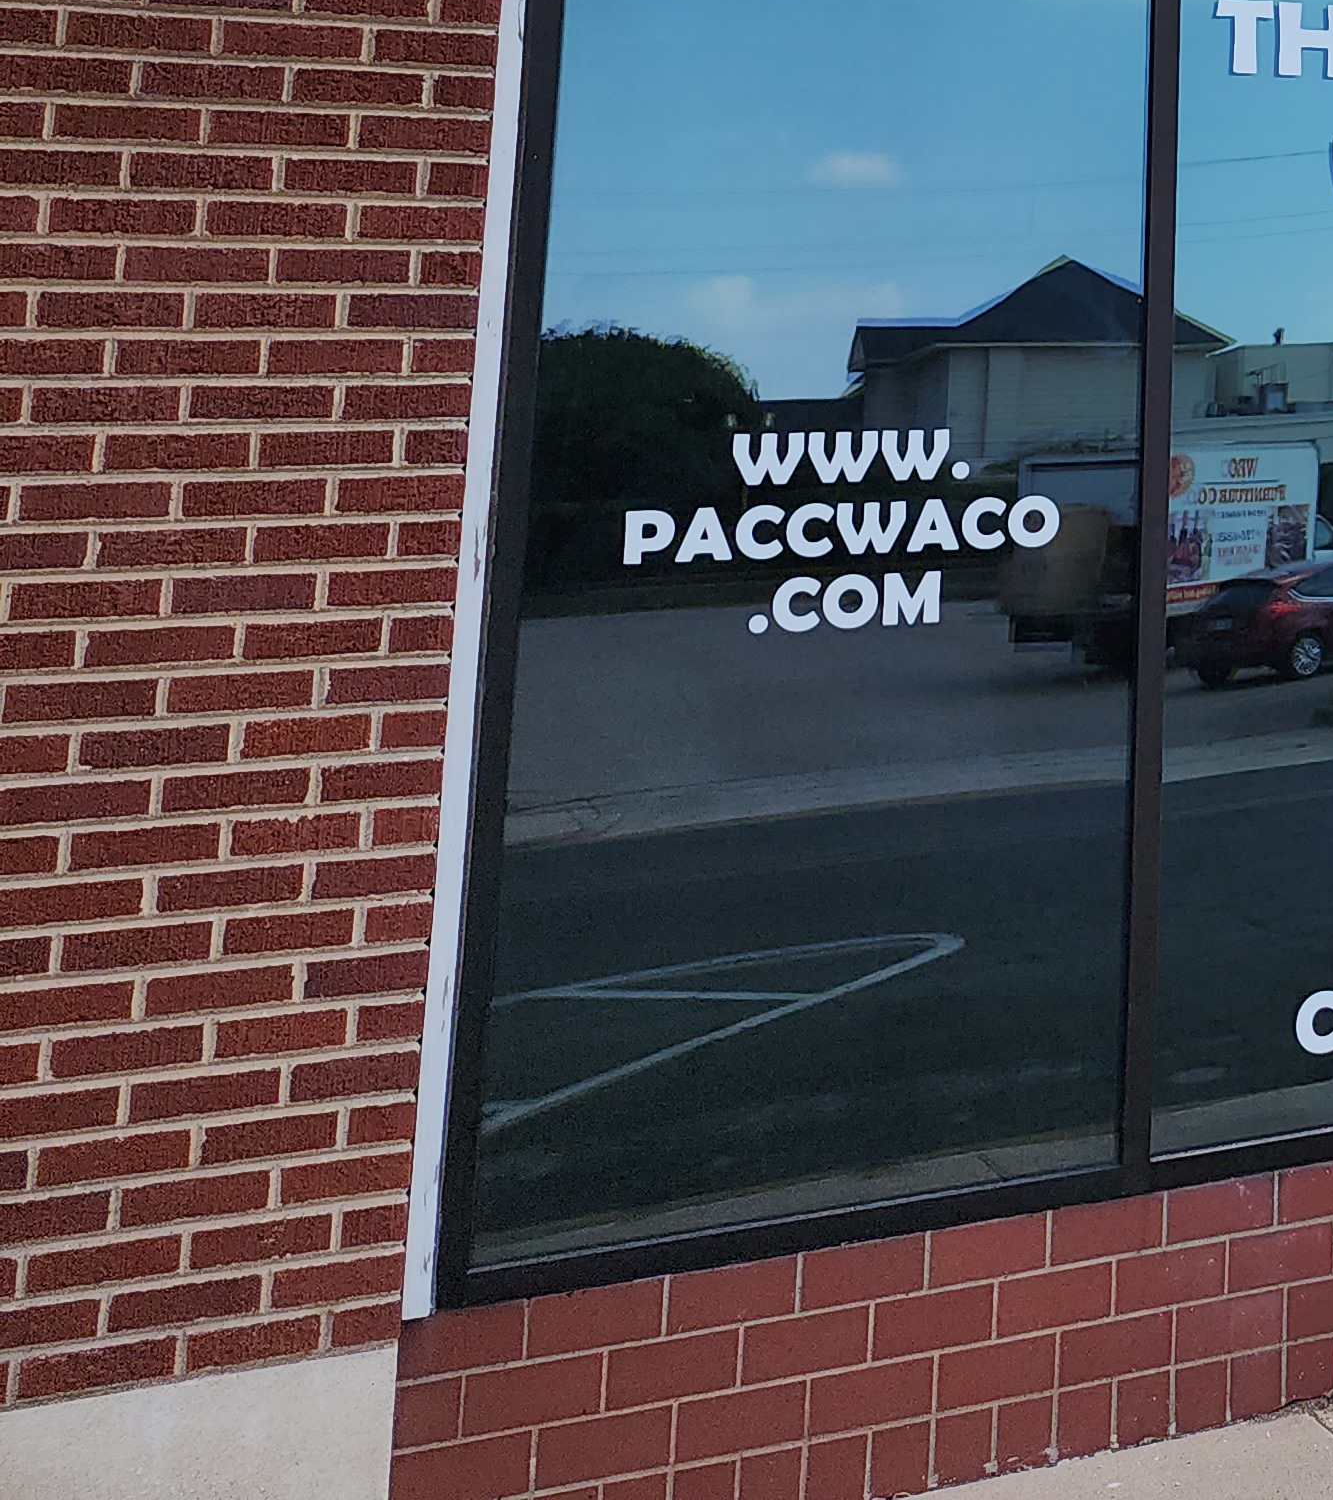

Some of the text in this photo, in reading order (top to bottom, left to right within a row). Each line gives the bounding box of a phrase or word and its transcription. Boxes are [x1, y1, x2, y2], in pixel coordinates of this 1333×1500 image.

[732, 428, 971, 486] WWW.
[623, 495, 1061, 565] PACCWACO
[747, 570, 942, 635] .COM
